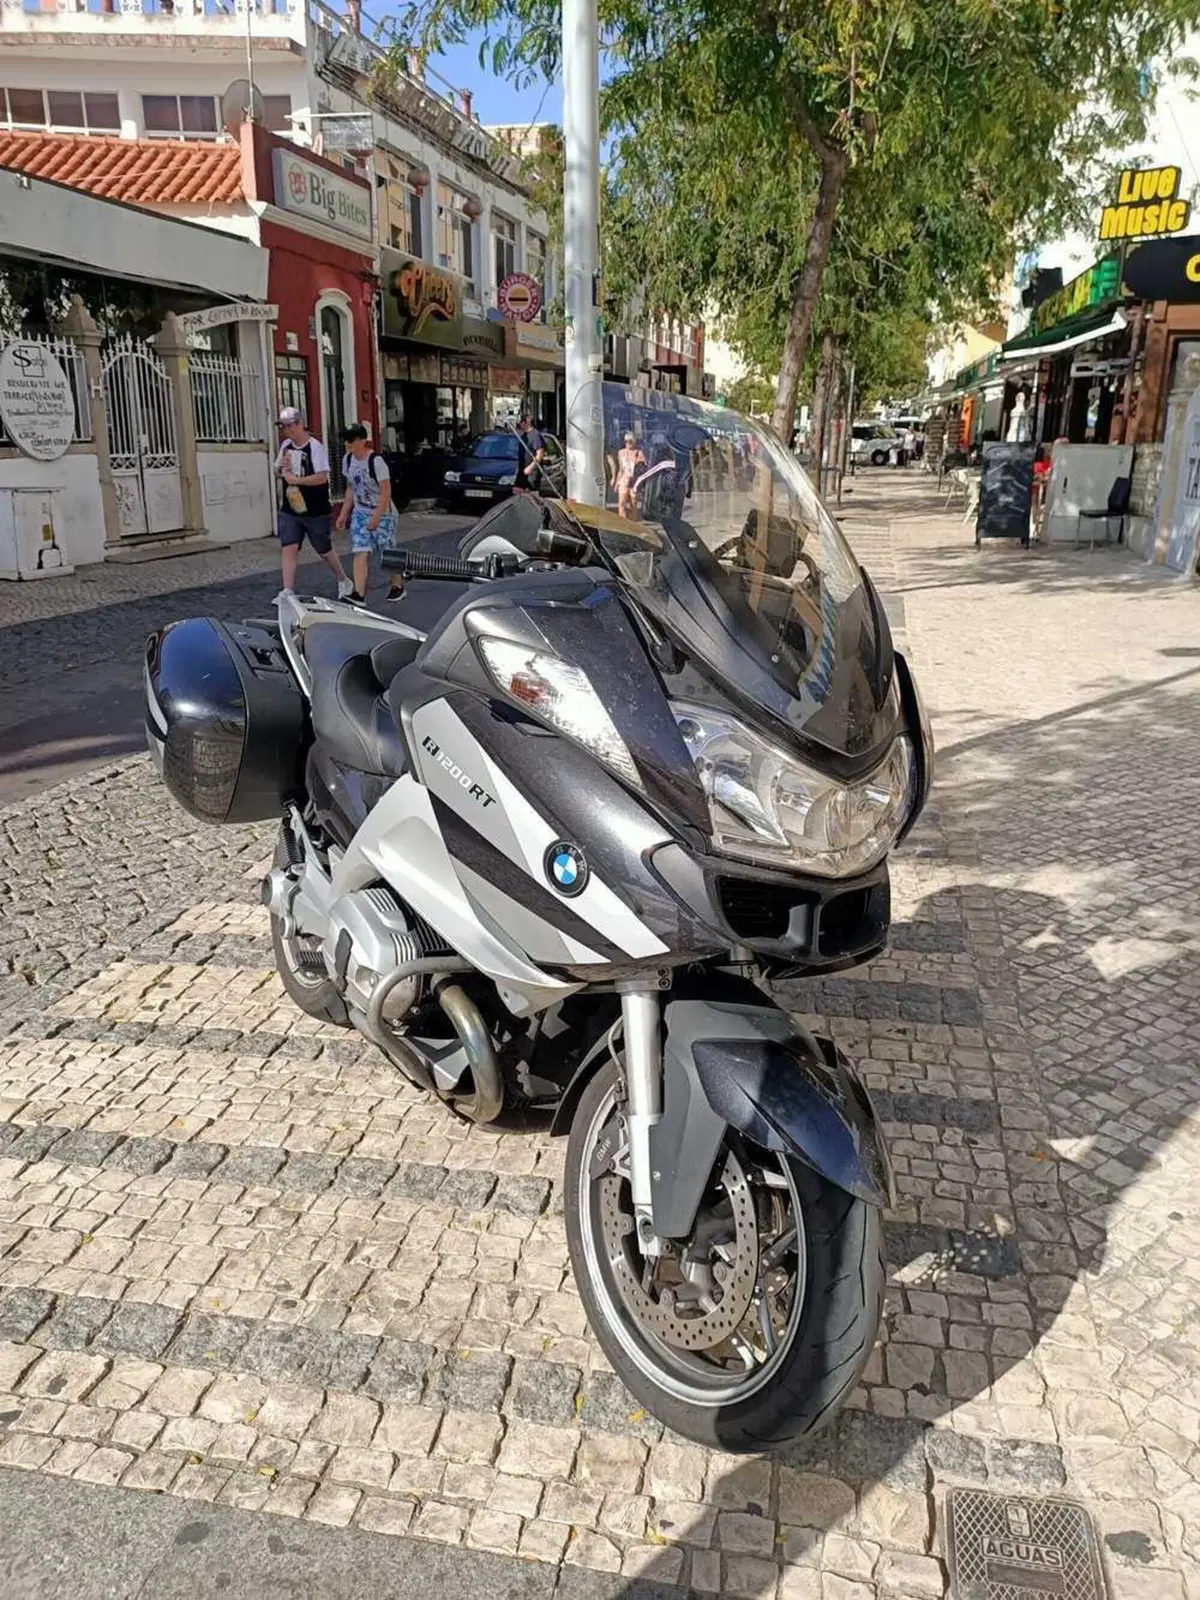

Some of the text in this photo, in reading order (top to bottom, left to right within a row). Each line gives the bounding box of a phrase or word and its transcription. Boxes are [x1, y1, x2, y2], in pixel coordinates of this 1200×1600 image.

[309, 172, 367, 226] Big Bites
[1118, 167, 1177, 202] Live
[1100, 199, 1187, 239] Music
[499, 274, 539, 297] BURGER
